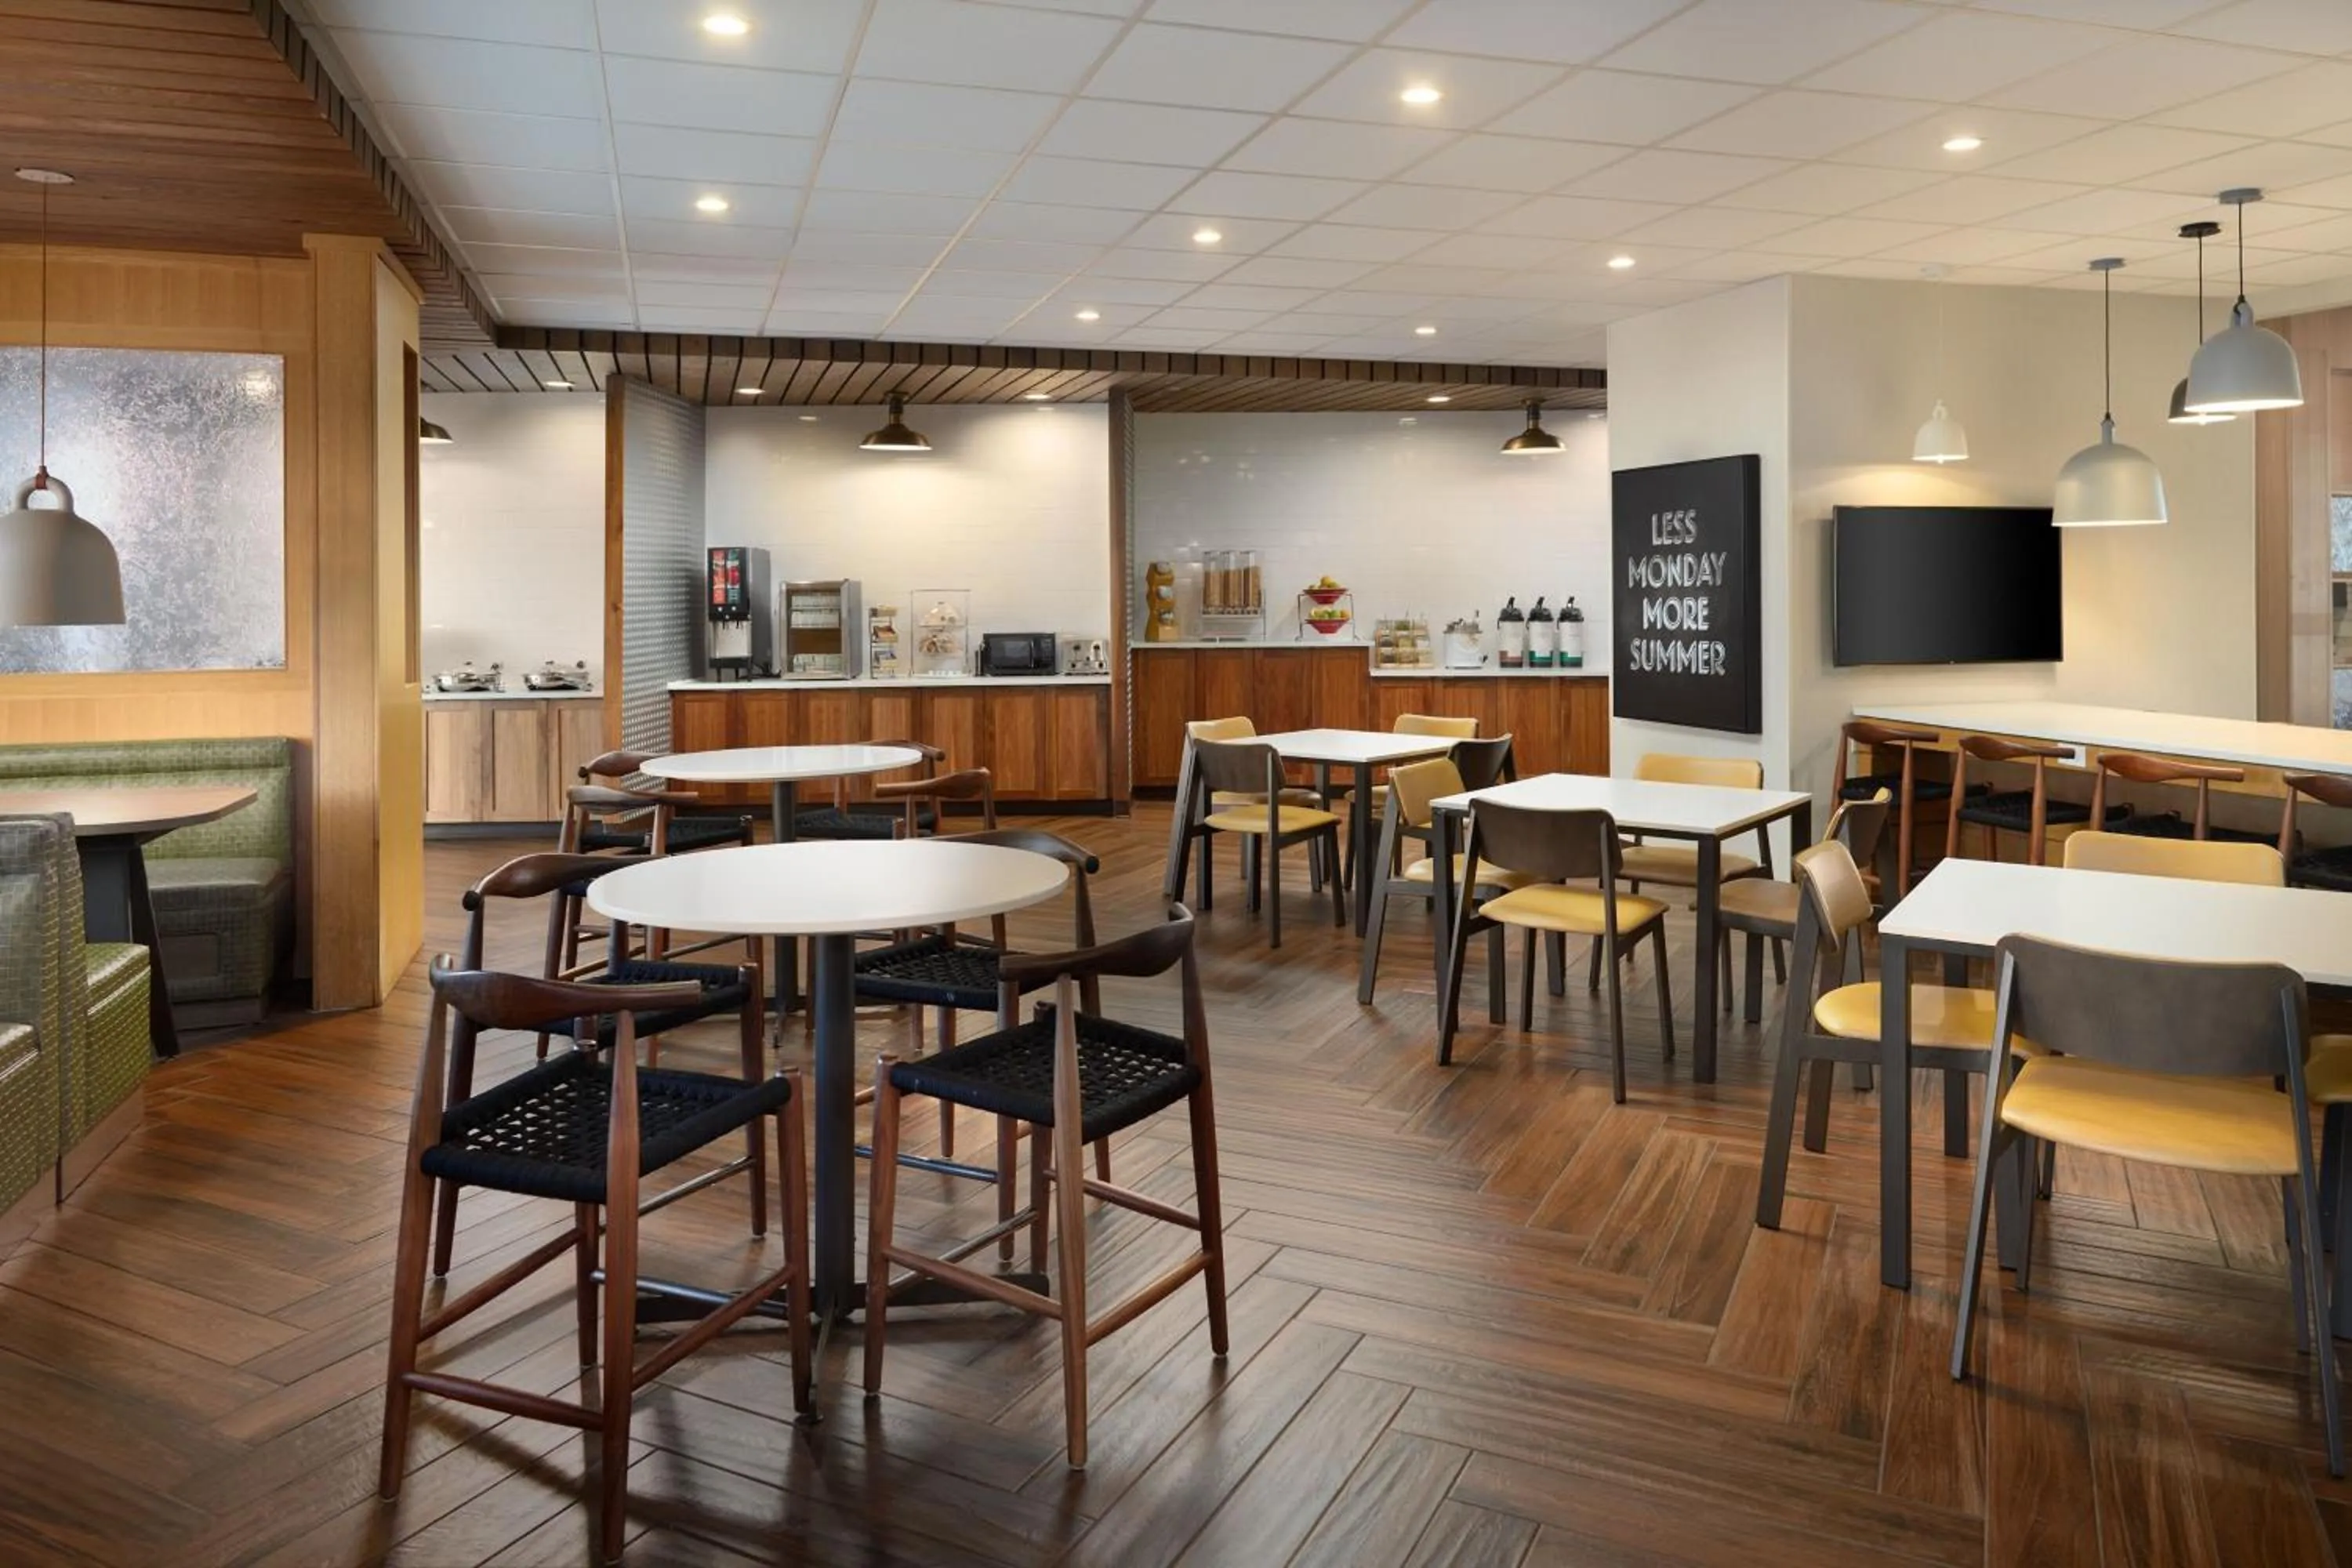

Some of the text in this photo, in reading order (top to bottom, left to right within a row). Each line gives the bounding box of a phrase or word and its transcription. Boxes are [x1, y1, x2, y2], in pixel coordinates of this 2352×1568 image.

[1652, 510, 1696, 545] LESS
[1628, 552, 1726, 588] MONDAY
[1642, 597, 1708, 630] MORE
[1630, 637, 1725, 675] SUMMER
